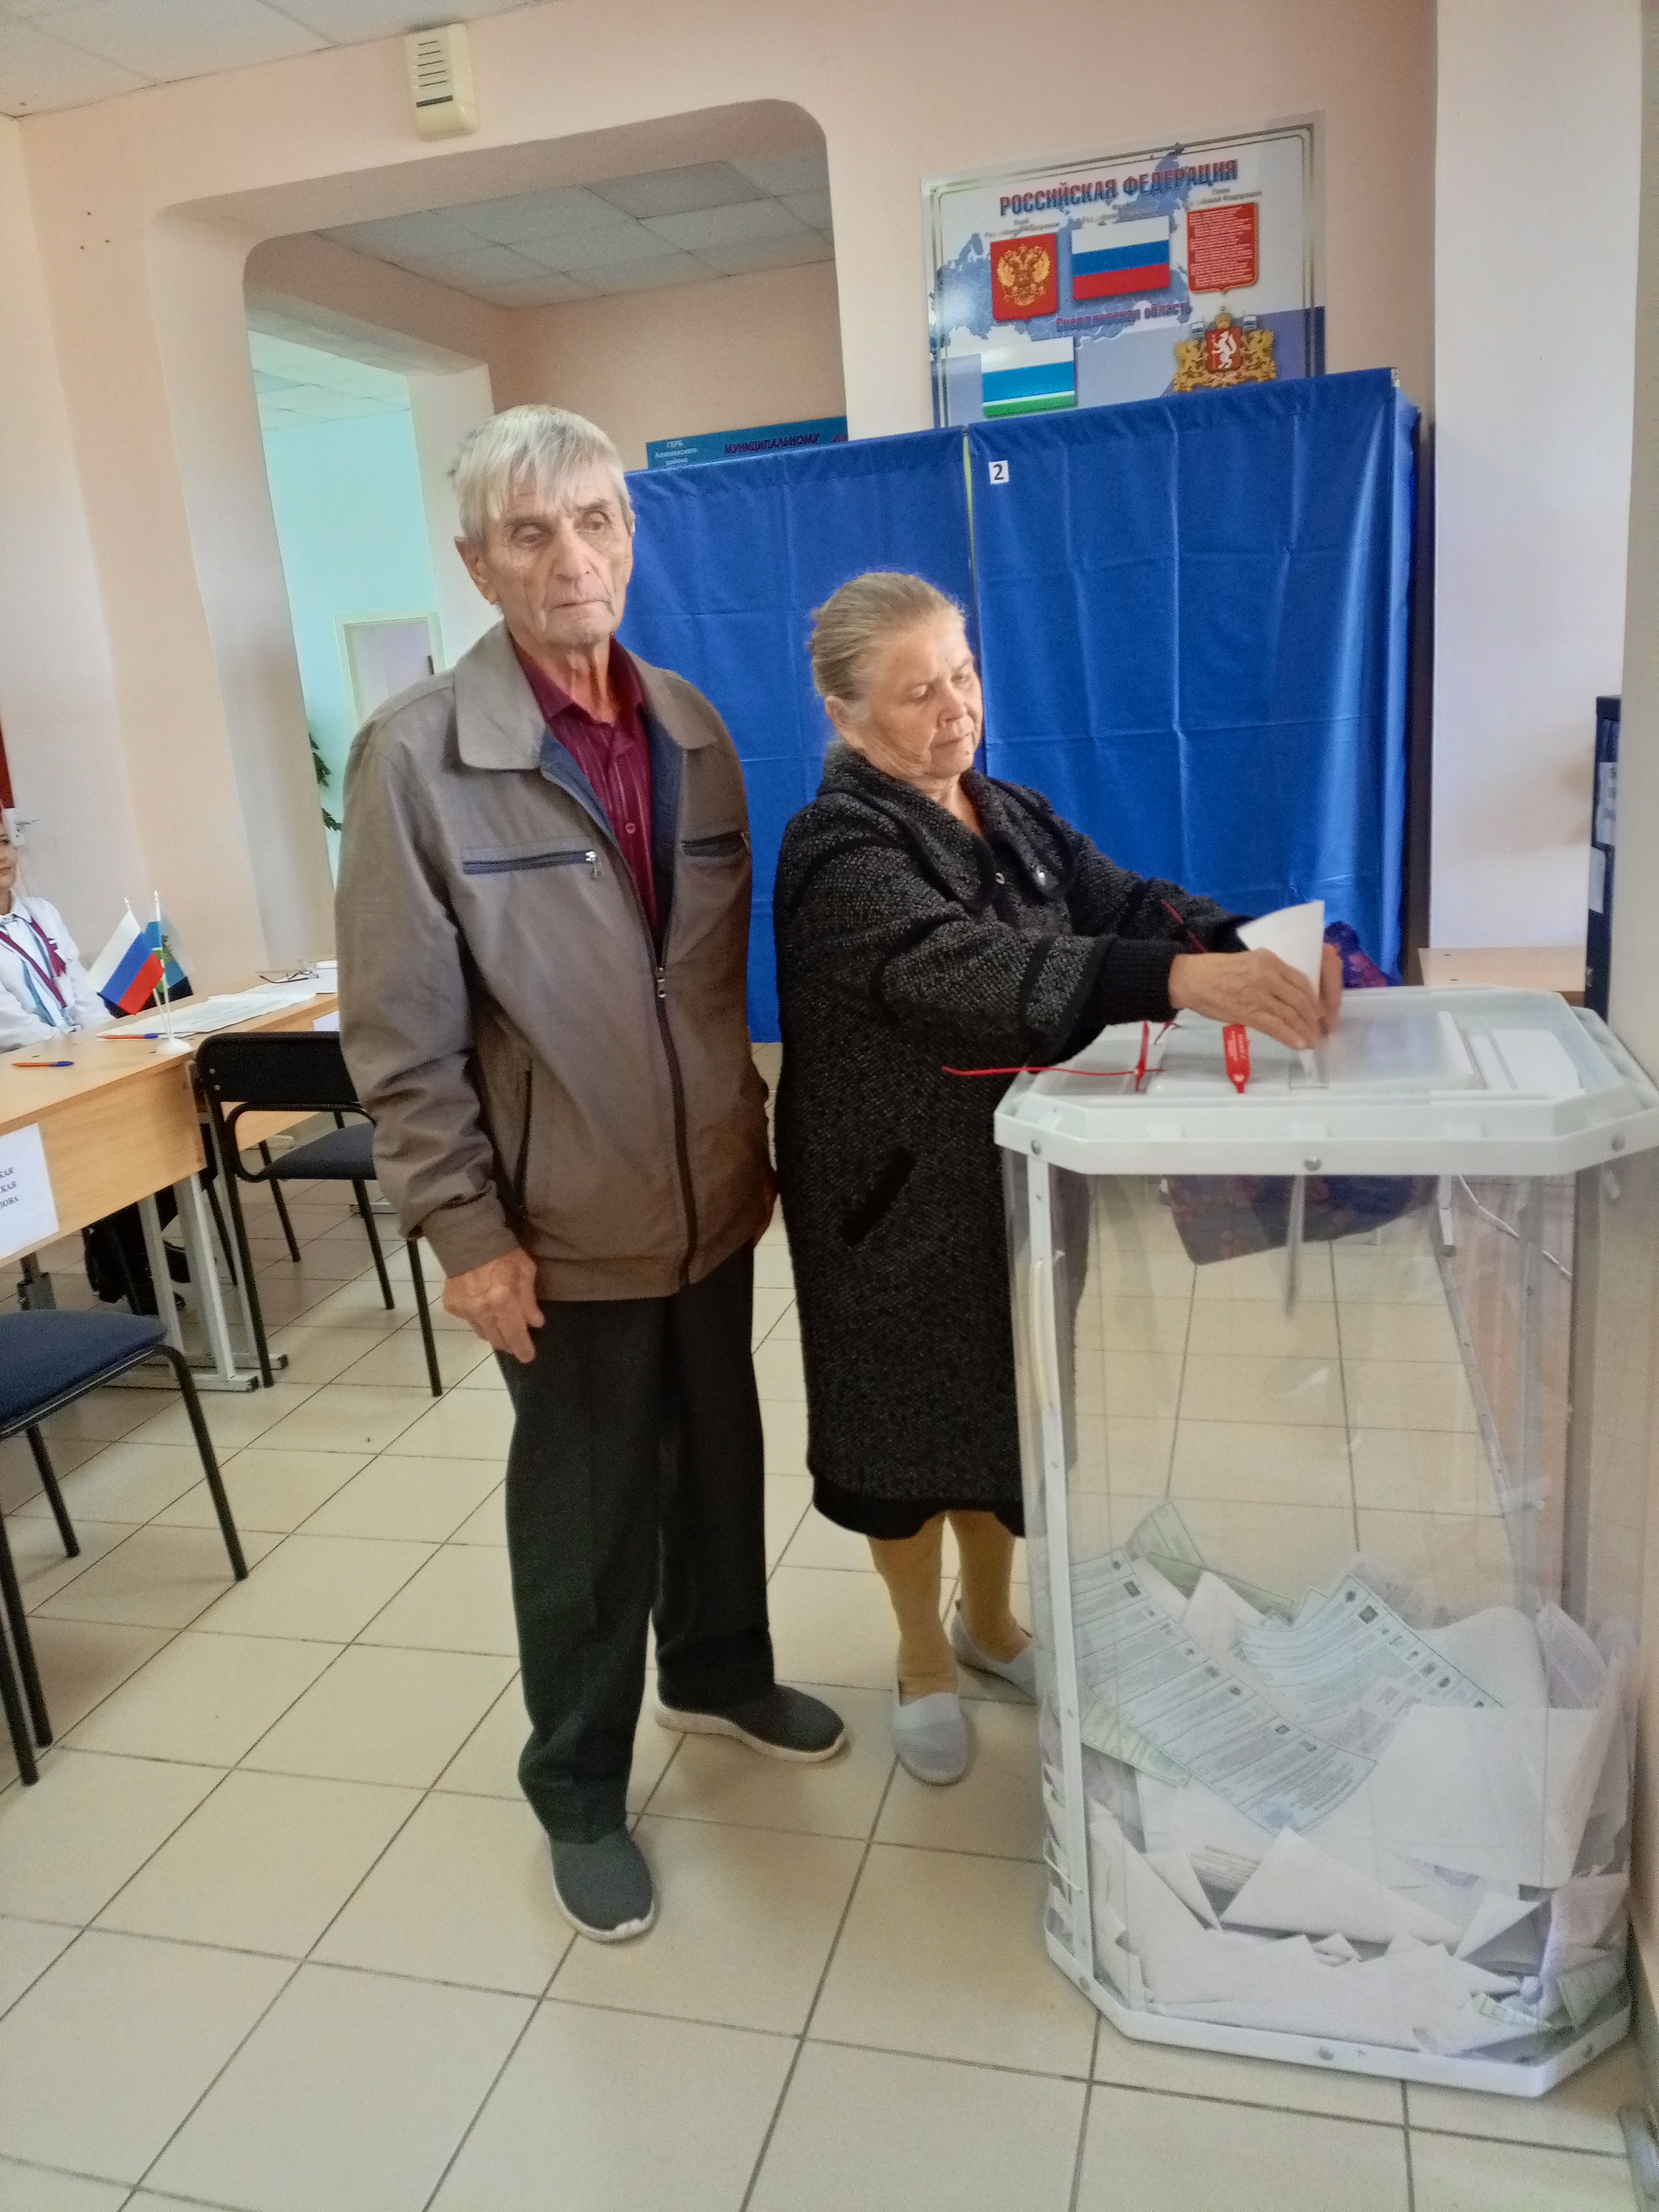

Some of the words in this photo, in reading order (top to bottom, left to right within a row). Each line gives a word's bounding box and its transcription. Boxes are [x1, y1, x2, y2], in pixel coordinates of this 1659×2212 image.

[999, 179, 1119, 216] РОССИЙСКАЯ
[1123, 159, 1238, 195] ФЕДЕРАЦИЯ
[993, 463, 1004, 480] 2
[0, 1181, 18, 1194] КАЯ
